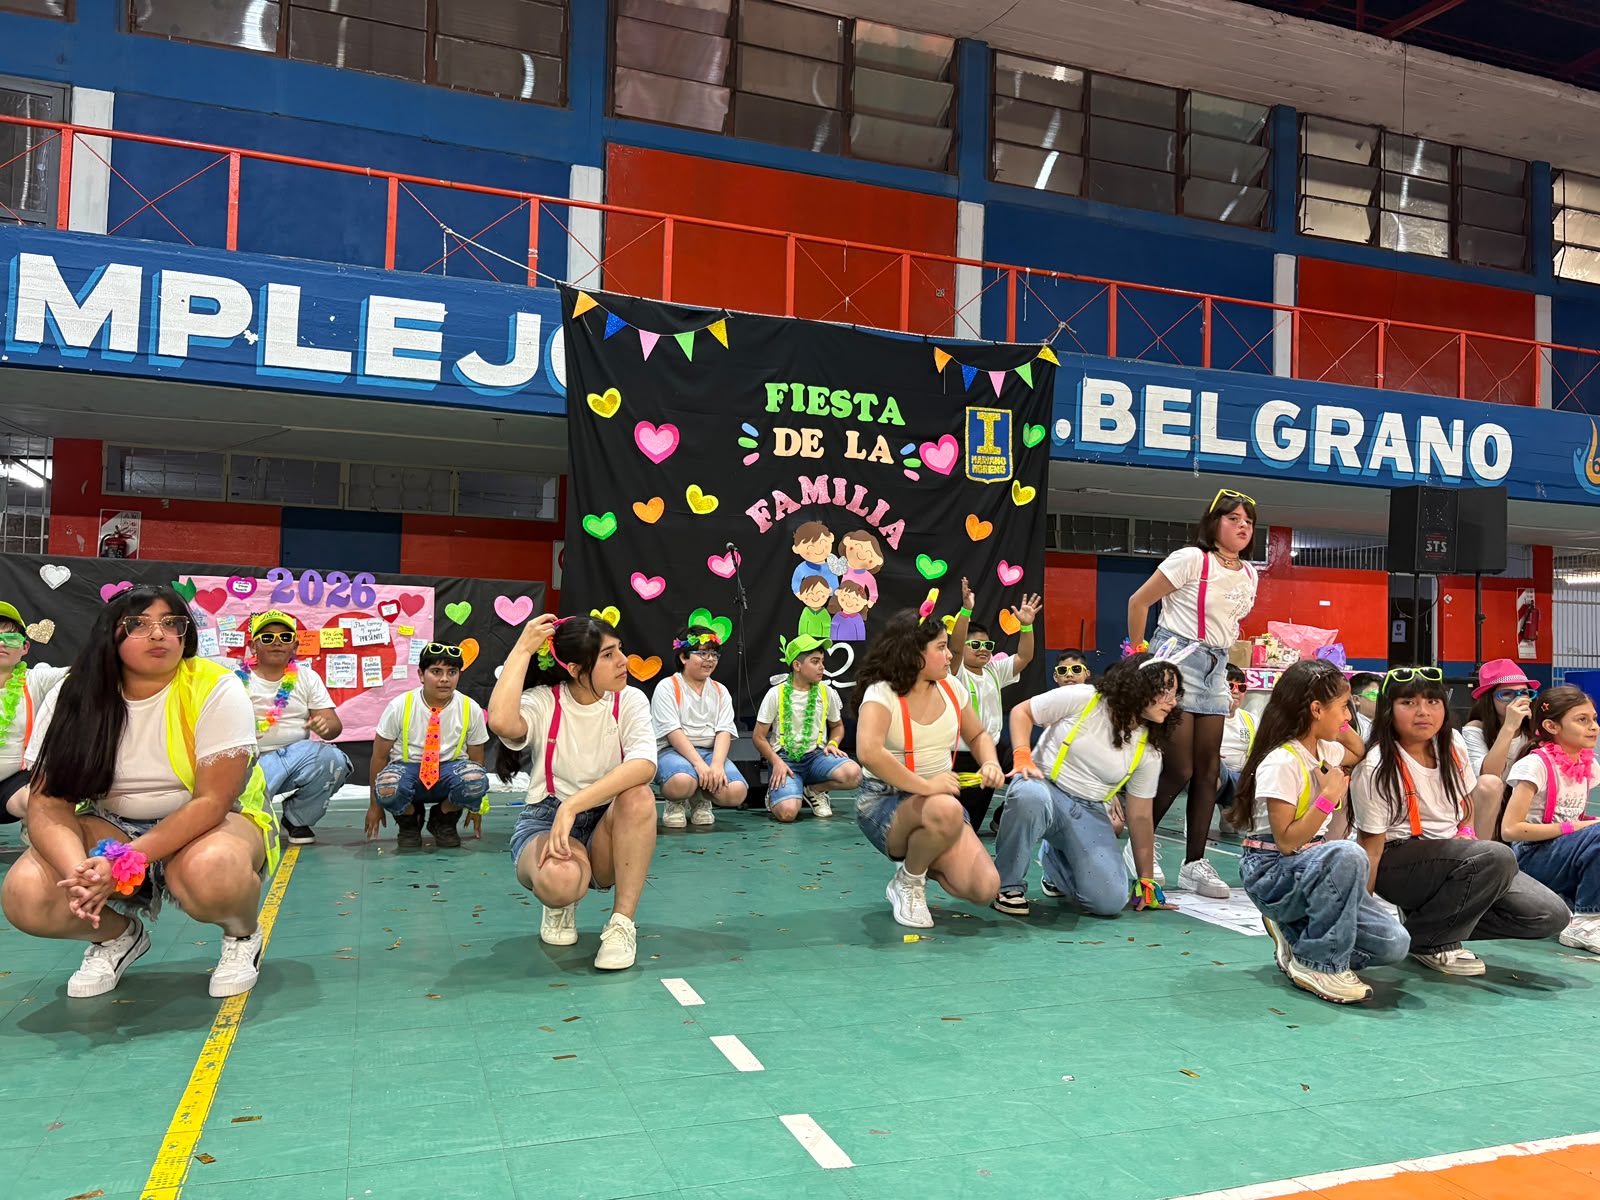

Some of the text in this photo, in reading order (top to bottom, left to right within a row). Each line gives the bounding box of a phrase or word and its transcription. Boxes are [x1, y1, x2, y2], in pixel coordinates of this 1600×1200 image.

[14, 252, 567, 388] MPLEJ
[764, 382, 906, 426] FIESTA
[773, 427, 895, 465] DE LA
[971, 455, 1007, 465] MARIANO
[972, 464, 1007, 475] MORENO
[745, 474, 906, 550] FAMILIA
[1425, 540, 1448, 553] STS
[266, 567, 377, 609] 2026
